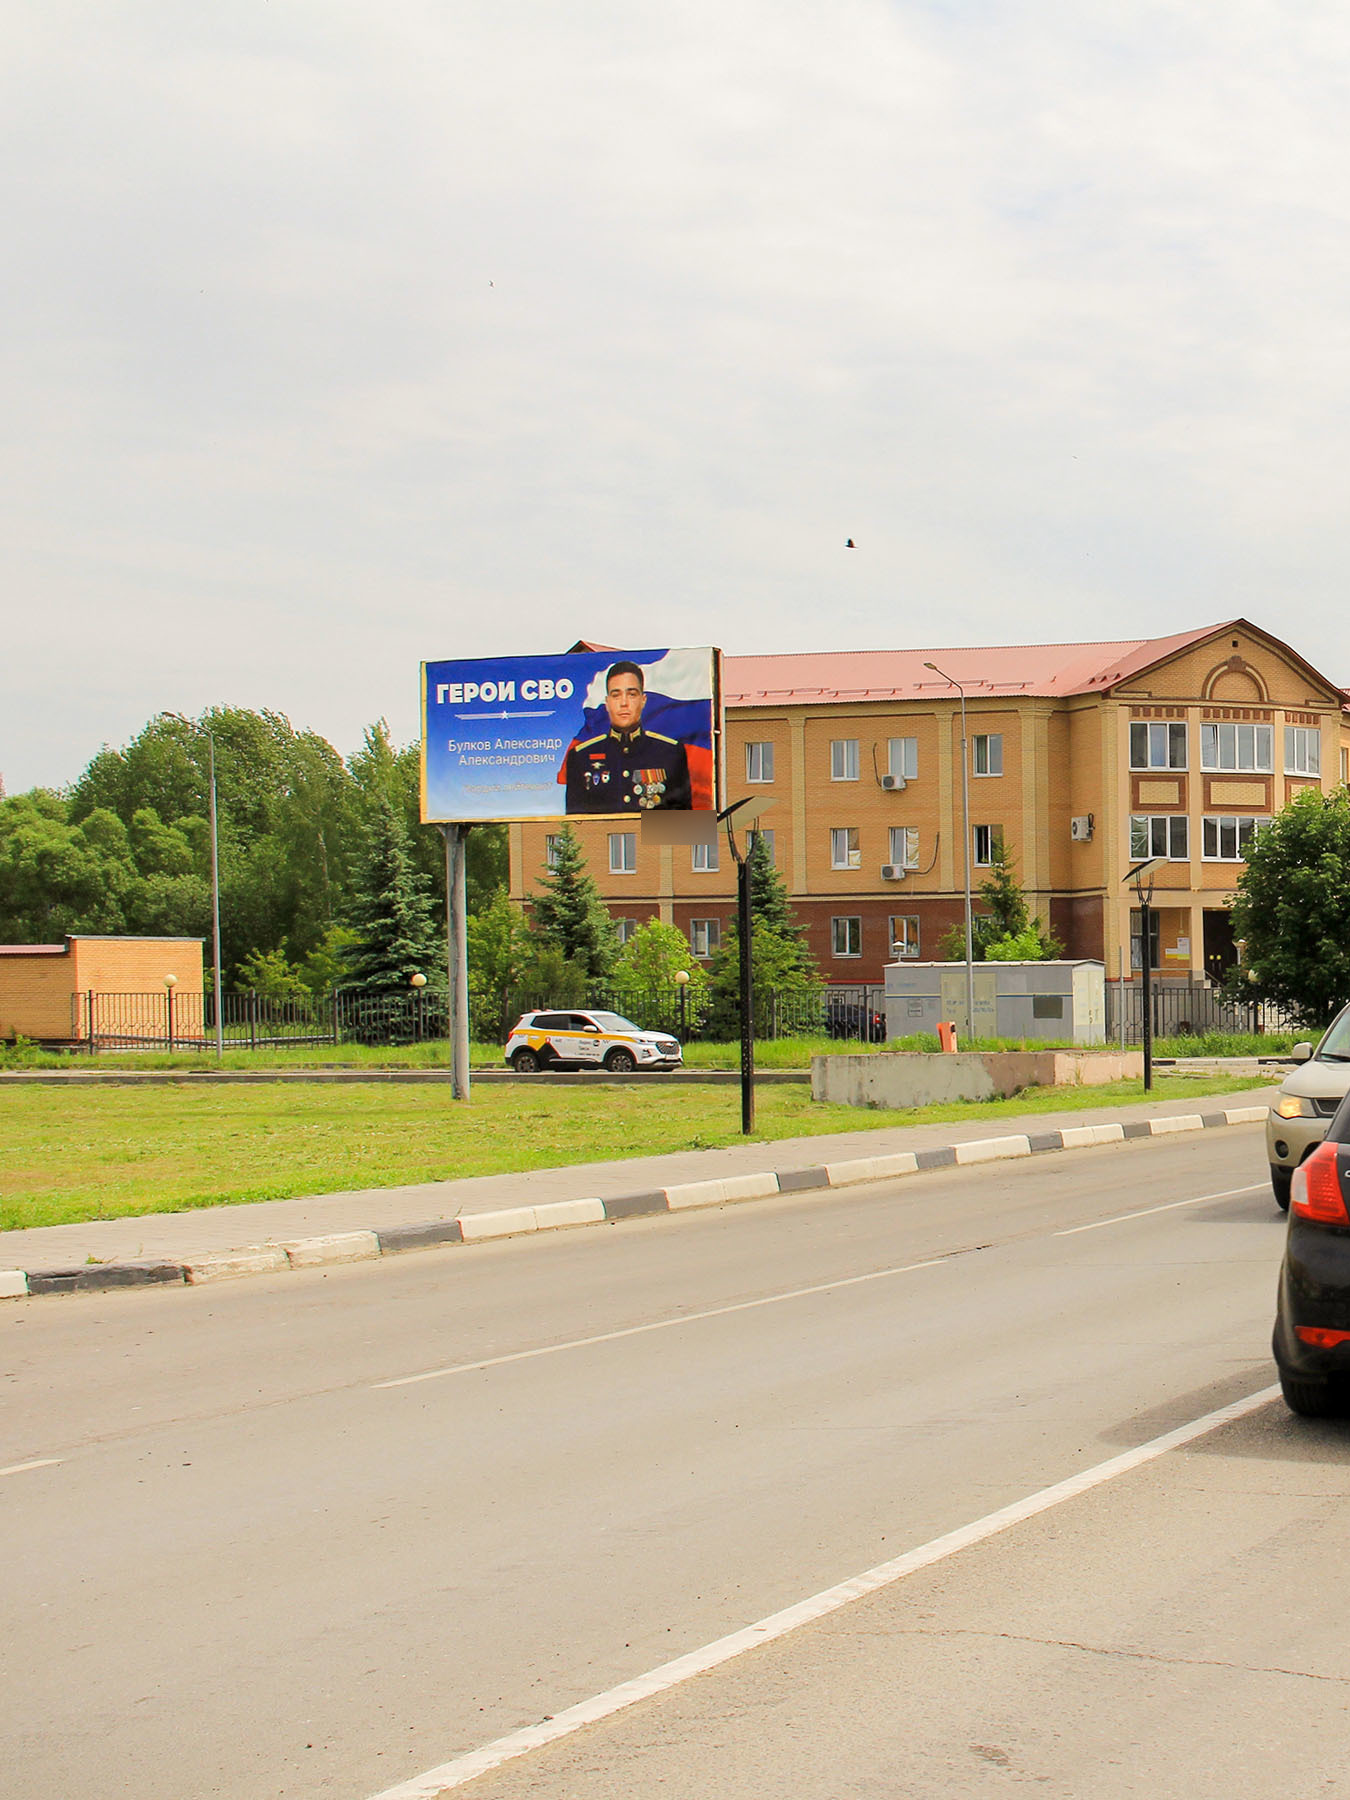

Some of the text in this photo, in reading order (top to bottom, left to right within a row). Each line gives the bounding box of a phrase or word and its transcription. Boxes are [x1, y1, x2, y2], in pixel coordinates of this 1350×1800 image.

[436, 678, 574, 704] ГЕРОИ СВО
[448, 738, 562, 753] Булков Александр
[459, 754, 555, 766] Александрович
